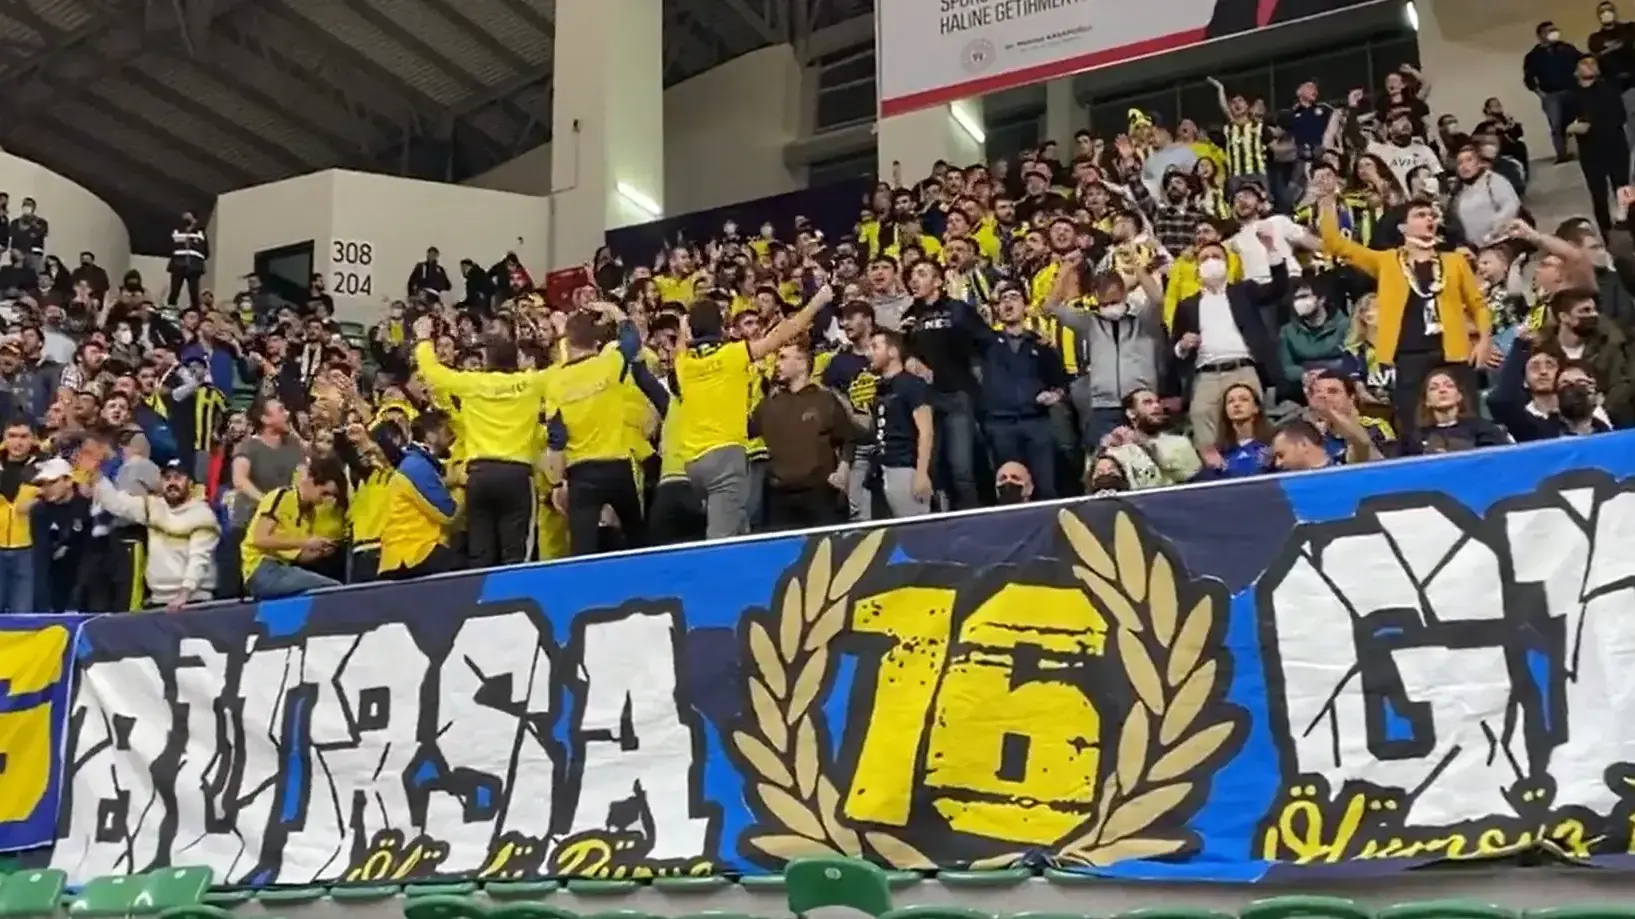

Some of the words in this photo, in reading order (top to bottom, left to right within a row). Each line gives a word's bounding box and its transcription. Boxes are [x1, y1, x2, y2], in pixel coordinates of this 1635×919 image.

[333, 241, 372, 265] 308
[333, 271, 371, 296] 204
[49, 611, 710, 885] BURSA
[844, 583, 1108, 846] 16
